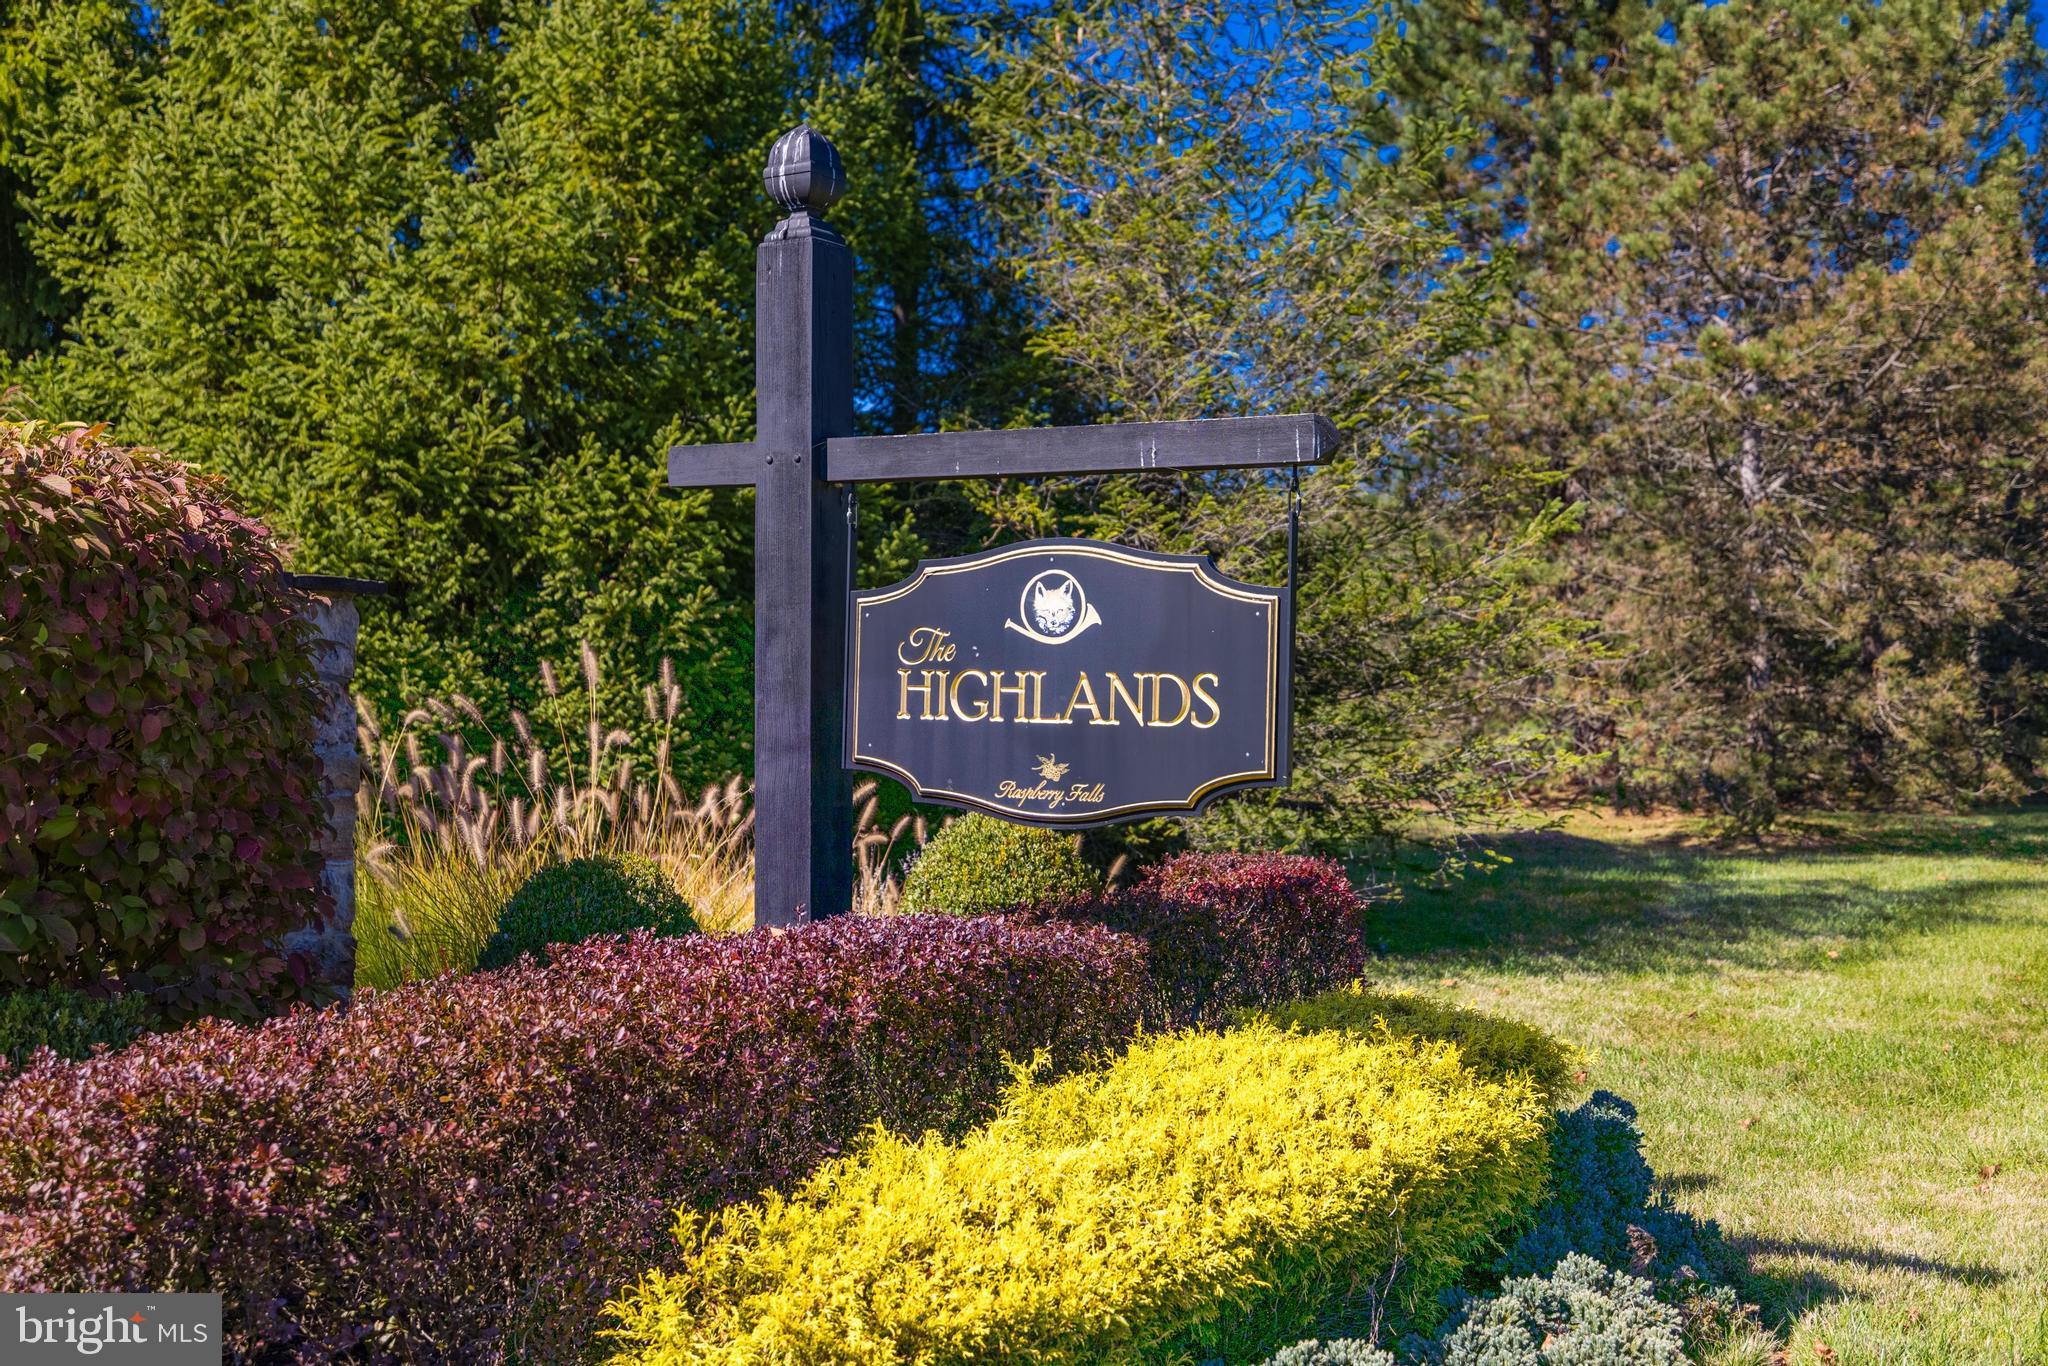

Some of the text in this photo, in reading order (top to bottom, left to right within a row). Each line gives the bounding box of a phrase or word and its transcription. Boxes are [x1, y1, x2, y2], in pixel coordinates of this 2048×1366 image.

[897, 626, 957, 666] The
[896, 668, 1221, 730] HIGHLANDS
[994, 779, 1105, 809] Raspberry Falls
